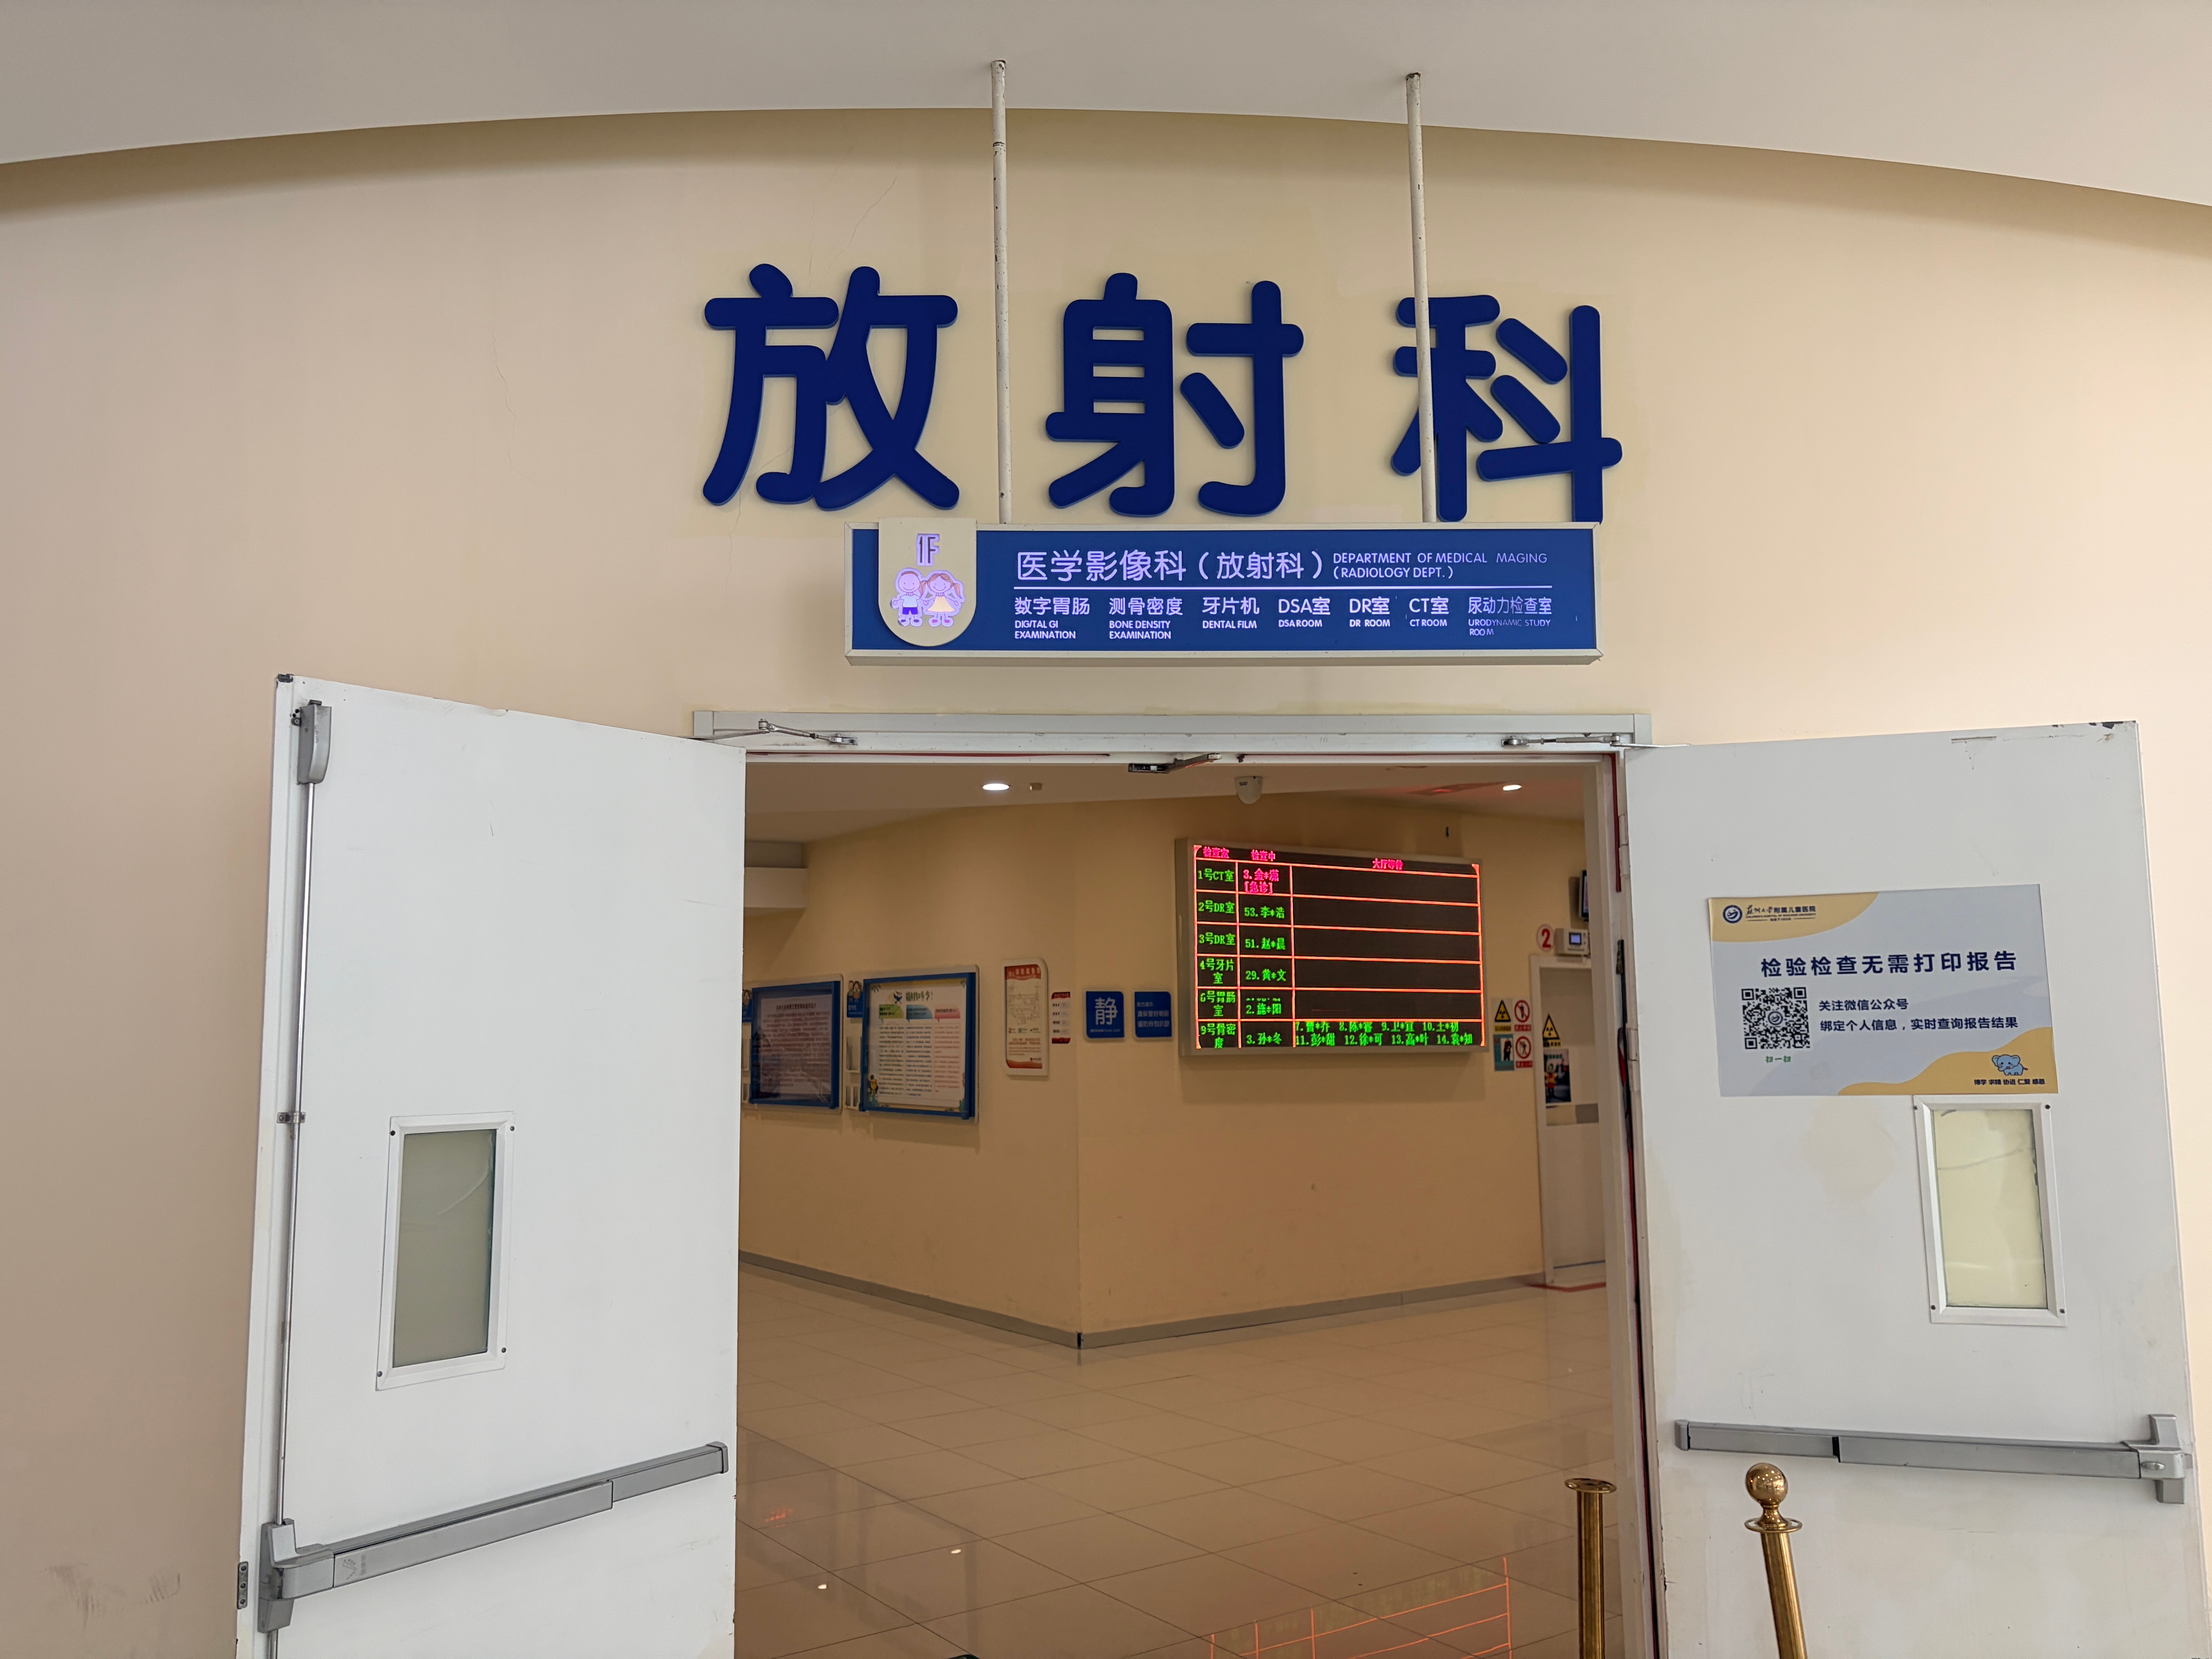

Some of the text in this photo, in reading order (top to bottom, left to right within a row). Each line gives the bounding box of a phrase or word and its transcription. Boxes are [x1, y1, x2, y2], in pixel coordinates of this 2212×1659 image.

[703, 263, 1623, 524] 放射科
[918, 535, 938, 565] 1F
[1333, 553, 1547, 563] DEPARTMENT OF MEDICAL MAGING
[1014, 596, 1090, 615] 数字胃肠
[1109, 597, 1183, 616] 测骨密度
[1202, 596, 1260, 615] 牙片机
[1278, 596, 1331, 615] DSA室
[1349, 596, 1390, 615] DR室
[1409, 596, 1449, 615] CT室
[1468, 596, 1552, 615] 尿动力检查室
[1014, 620, 1058, 629] DIGITAL GI
[1109, 620, 1171, 629] BONE DENSITY
[1202, 620, 1257, 629] DENTAL FILM
[1349, 619, 1390, 627] DR ROOM
[1410, 619, 1420, 627] CT
[1014, 630, 1076, 639] EXAMINATION
[1109, 630, 1171, 639] EXAMINATION
[1202, 846, 1230, 859] 检查室
[1251, 849, 1276, 862] 检查中
[1198, 868, 1235, 882] 1号CT室
[1198, 900, 1235, 914] 2号DR室
[1199, 932, 1236, 945] 3号DR室
[1541, 928, 1551, 949] 2
[1200, 958, 1234, 971] 4号牙片
[1761, 950, 2016, 977] 检验检查无需打印报告
[1213, 972, 1223, 984] 室
[1094, 997, 1118, 1025] 静
[1213, 1004, 1224, 1017] 室
[1819, 998, 1909, 1012] 关注微信公众号
[1201, 1023, 1236, 1036] 9号骨密
[1214, 1037, 1224, 1049] 度
